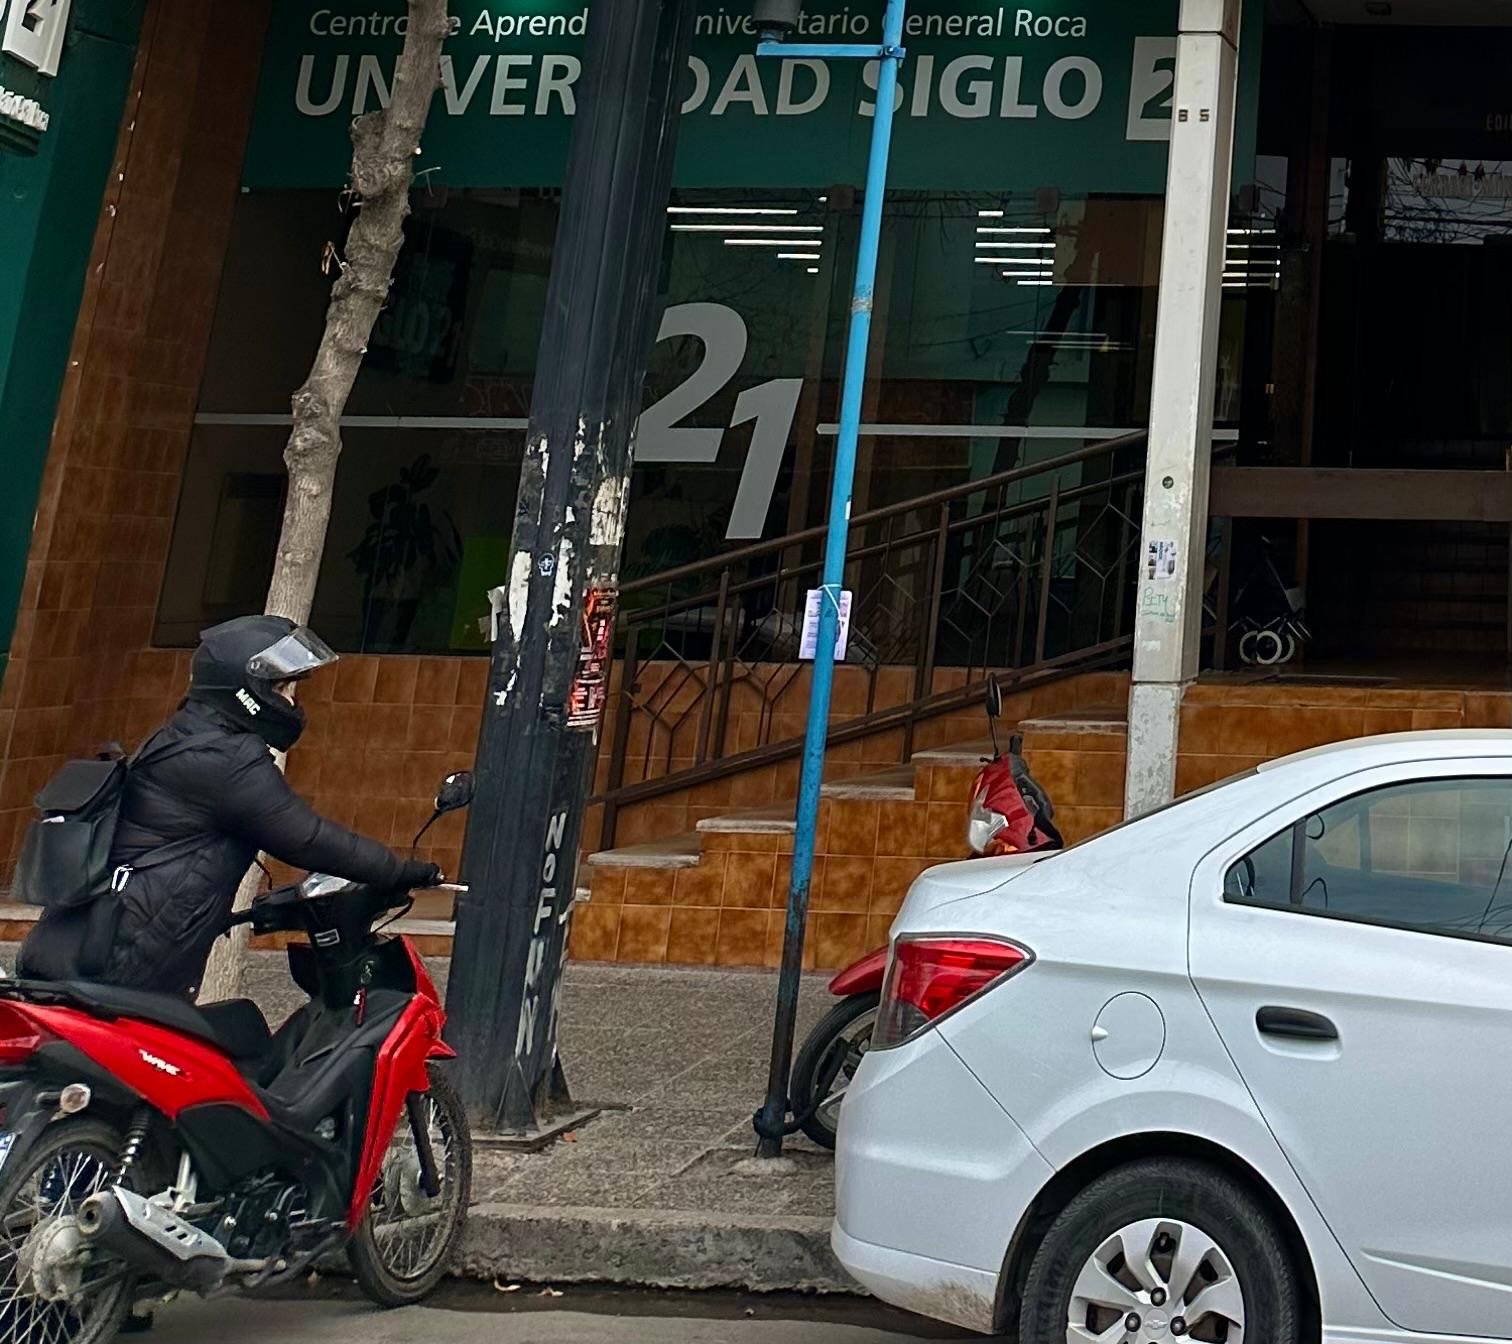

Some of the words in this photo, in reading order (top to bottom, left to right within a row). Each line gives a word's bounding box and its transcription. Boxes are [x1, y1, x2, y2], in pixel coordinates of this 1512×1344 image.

[882, 7, 1005, 37] eneral
[1014, 8, 1088, 38] Roca
[858, 54, 1103, 120] SIGLO
[634, 302, 804, 540] 21
